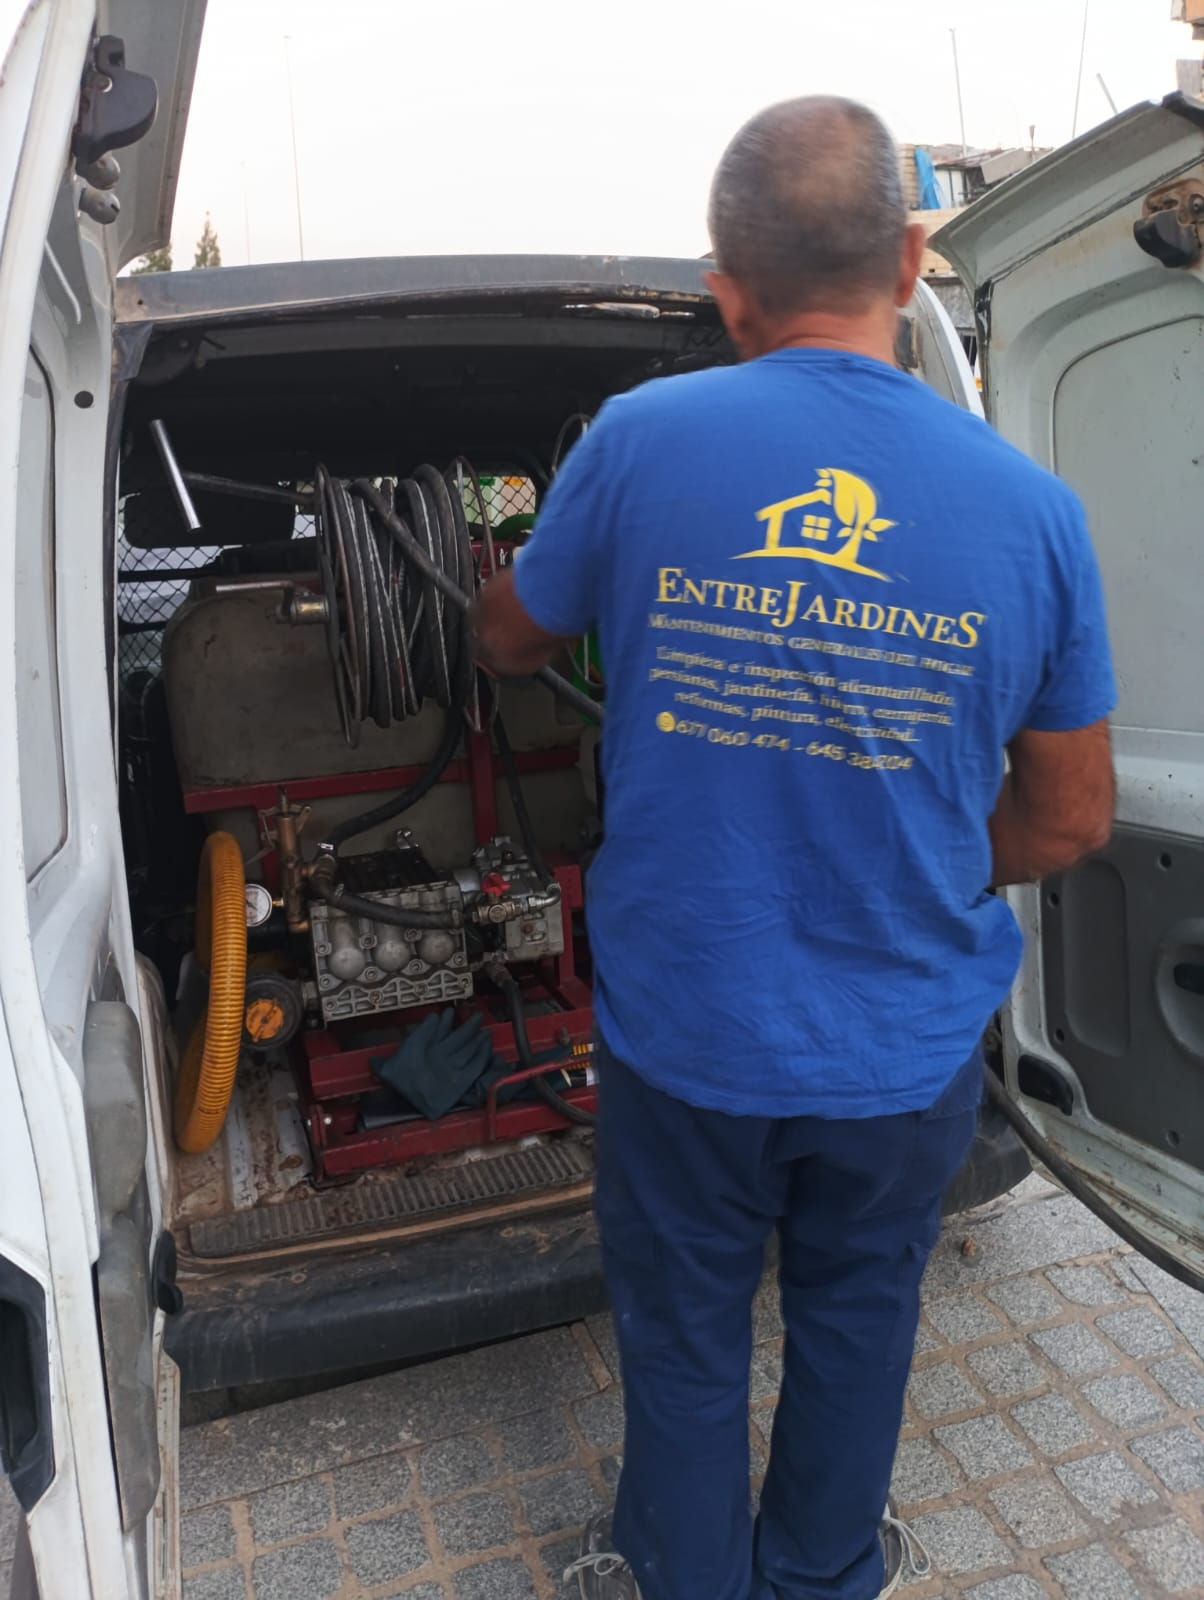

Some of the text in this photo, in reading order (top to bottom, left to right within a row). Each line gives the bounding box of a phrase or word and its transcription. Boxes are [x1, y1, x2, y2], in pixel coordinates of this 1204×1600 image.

[728, 661, 741, 673] e
[752, 733, 791, 751] 474
[806, 741, 847, 761] 645
